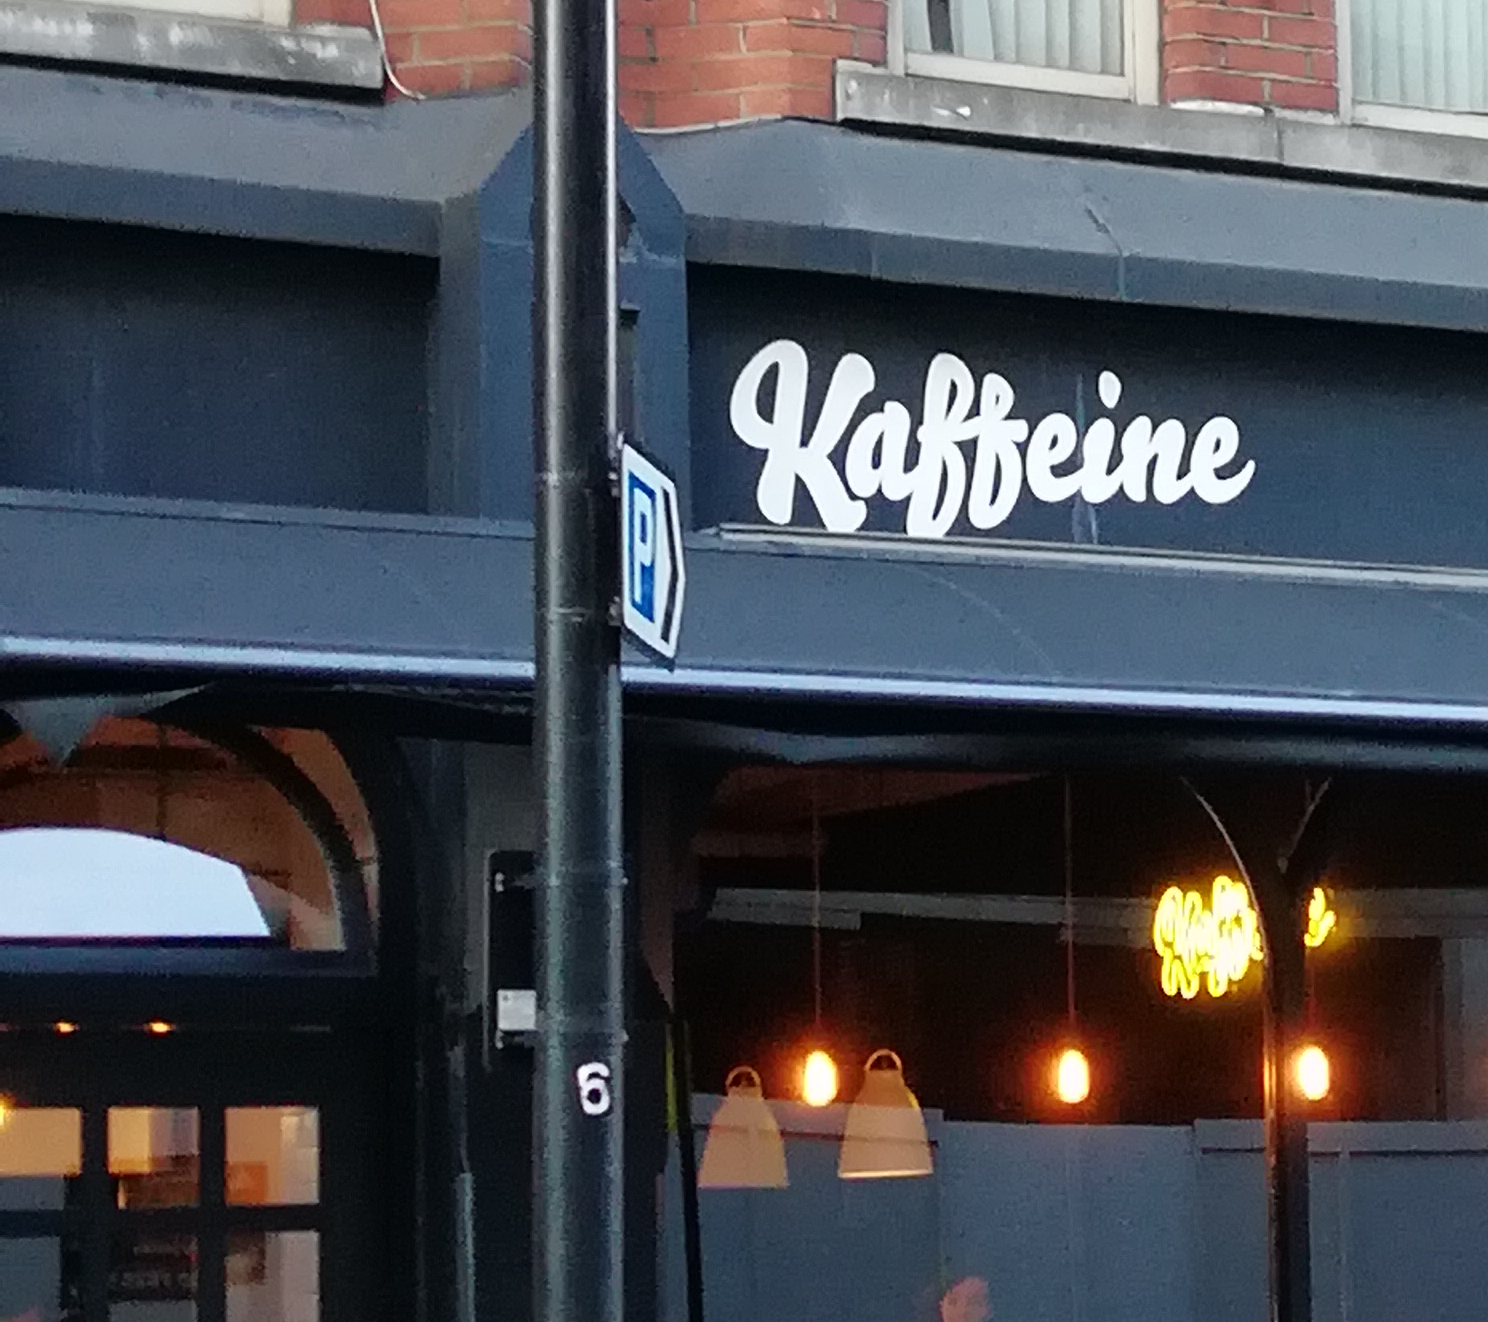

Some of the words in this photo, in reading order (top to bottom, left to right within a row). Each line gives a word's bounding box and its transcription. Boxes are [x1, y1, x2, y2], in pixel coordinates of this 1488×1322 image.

[729, 338, 1256, 538] Kaffeine
[632, 485, 656, 607] P
[576, 1061, 611, 1116] 6
